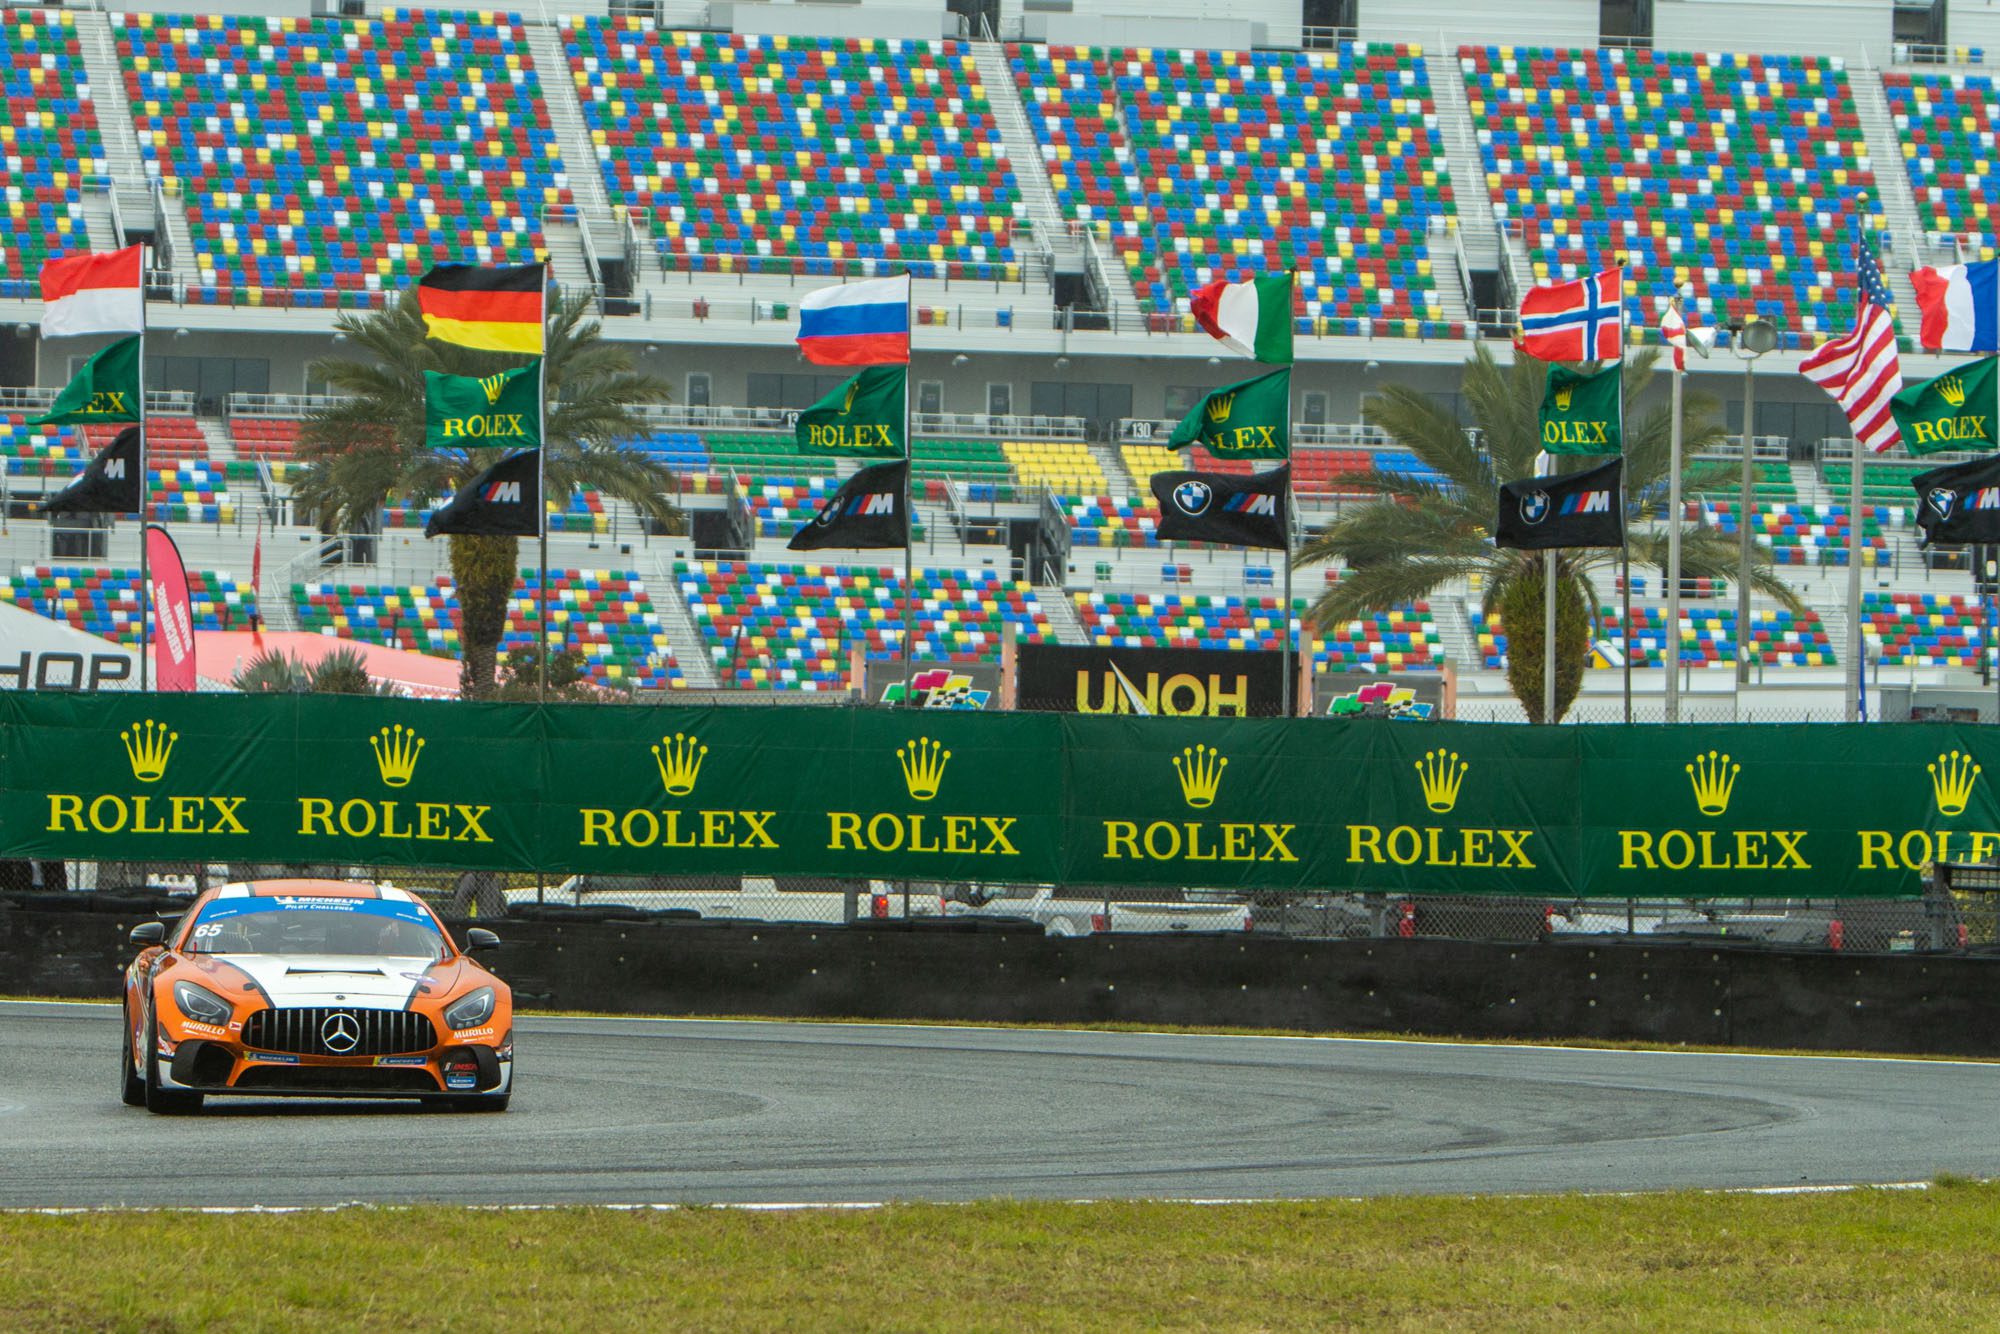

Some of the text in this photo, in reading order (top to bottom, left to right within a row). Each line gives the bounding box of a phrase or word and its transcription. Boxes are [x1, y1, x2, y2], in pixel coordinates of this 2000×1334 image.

[443, 414, 525, 437] ROLEX
[808, 424, 893, 447] ROLEX
[1132, 422, 1151, 438] 130
[1543, 420, 1608, 444] OLEX
[1911, 415, 1987, 444] ROLEX
[1076, 669, 1248, 717] UNOH
[46, 793, 250, 835] ROLEX
[298, 796, 494, 843] ROLEX
[579, 807, 780, 849] ROLEX
[826, 811, 1021, 855] ROLEX
[1102, 819, 1299, 862] ROLEX
[1345, 823, 1538, 869] ROLEX
[1618, 828, 1812, 870] ROLEX
[298, 896, 366, 906] MICHELIN
[310, 903, 355, 912] CHALLENGE
[194, 922, 224, 938] 65
[180, 1020, 226, 1036] MURILLO
[453, 1027, 495, 1040] MURILLO
